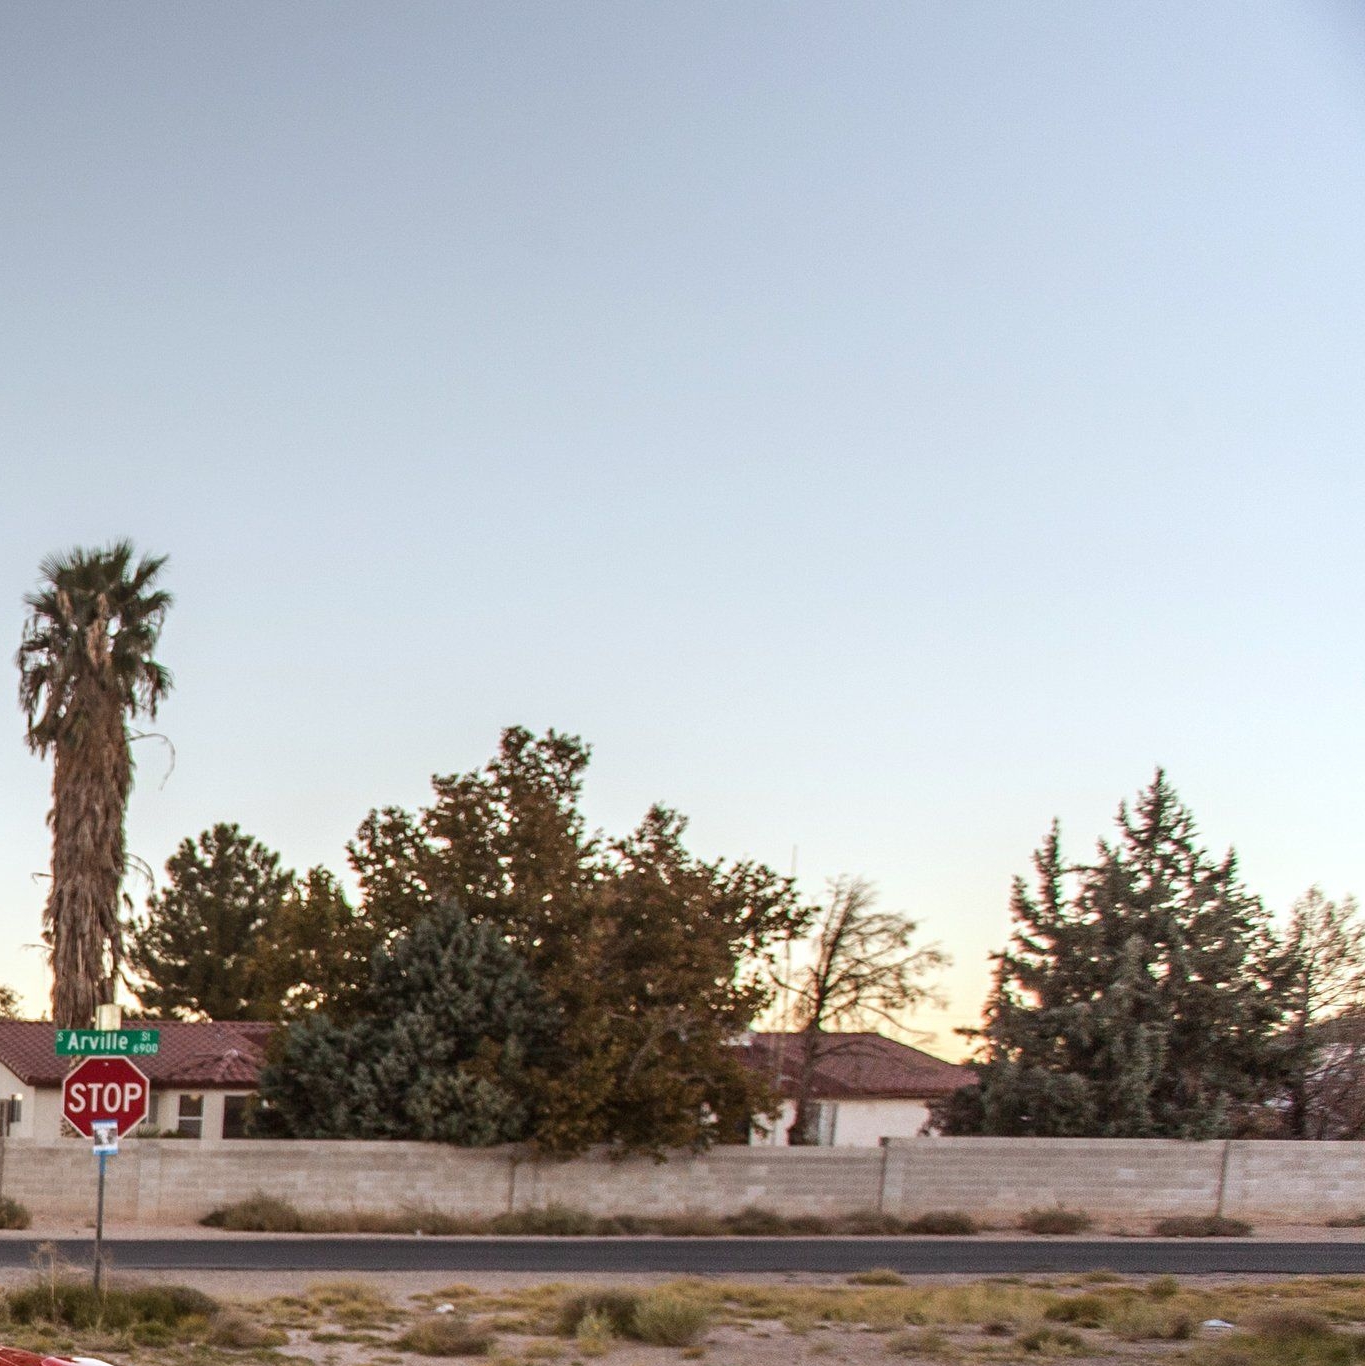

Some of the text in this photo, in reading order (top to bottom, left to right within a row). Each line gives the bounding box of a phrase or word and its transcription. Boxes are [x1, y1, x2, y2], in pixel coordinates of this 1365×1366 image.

[57, 1031, 151, 1050] S Arville St
[133, 1043, 158, 1054] 6900
[69, 1083, 142, 1113] STOP
